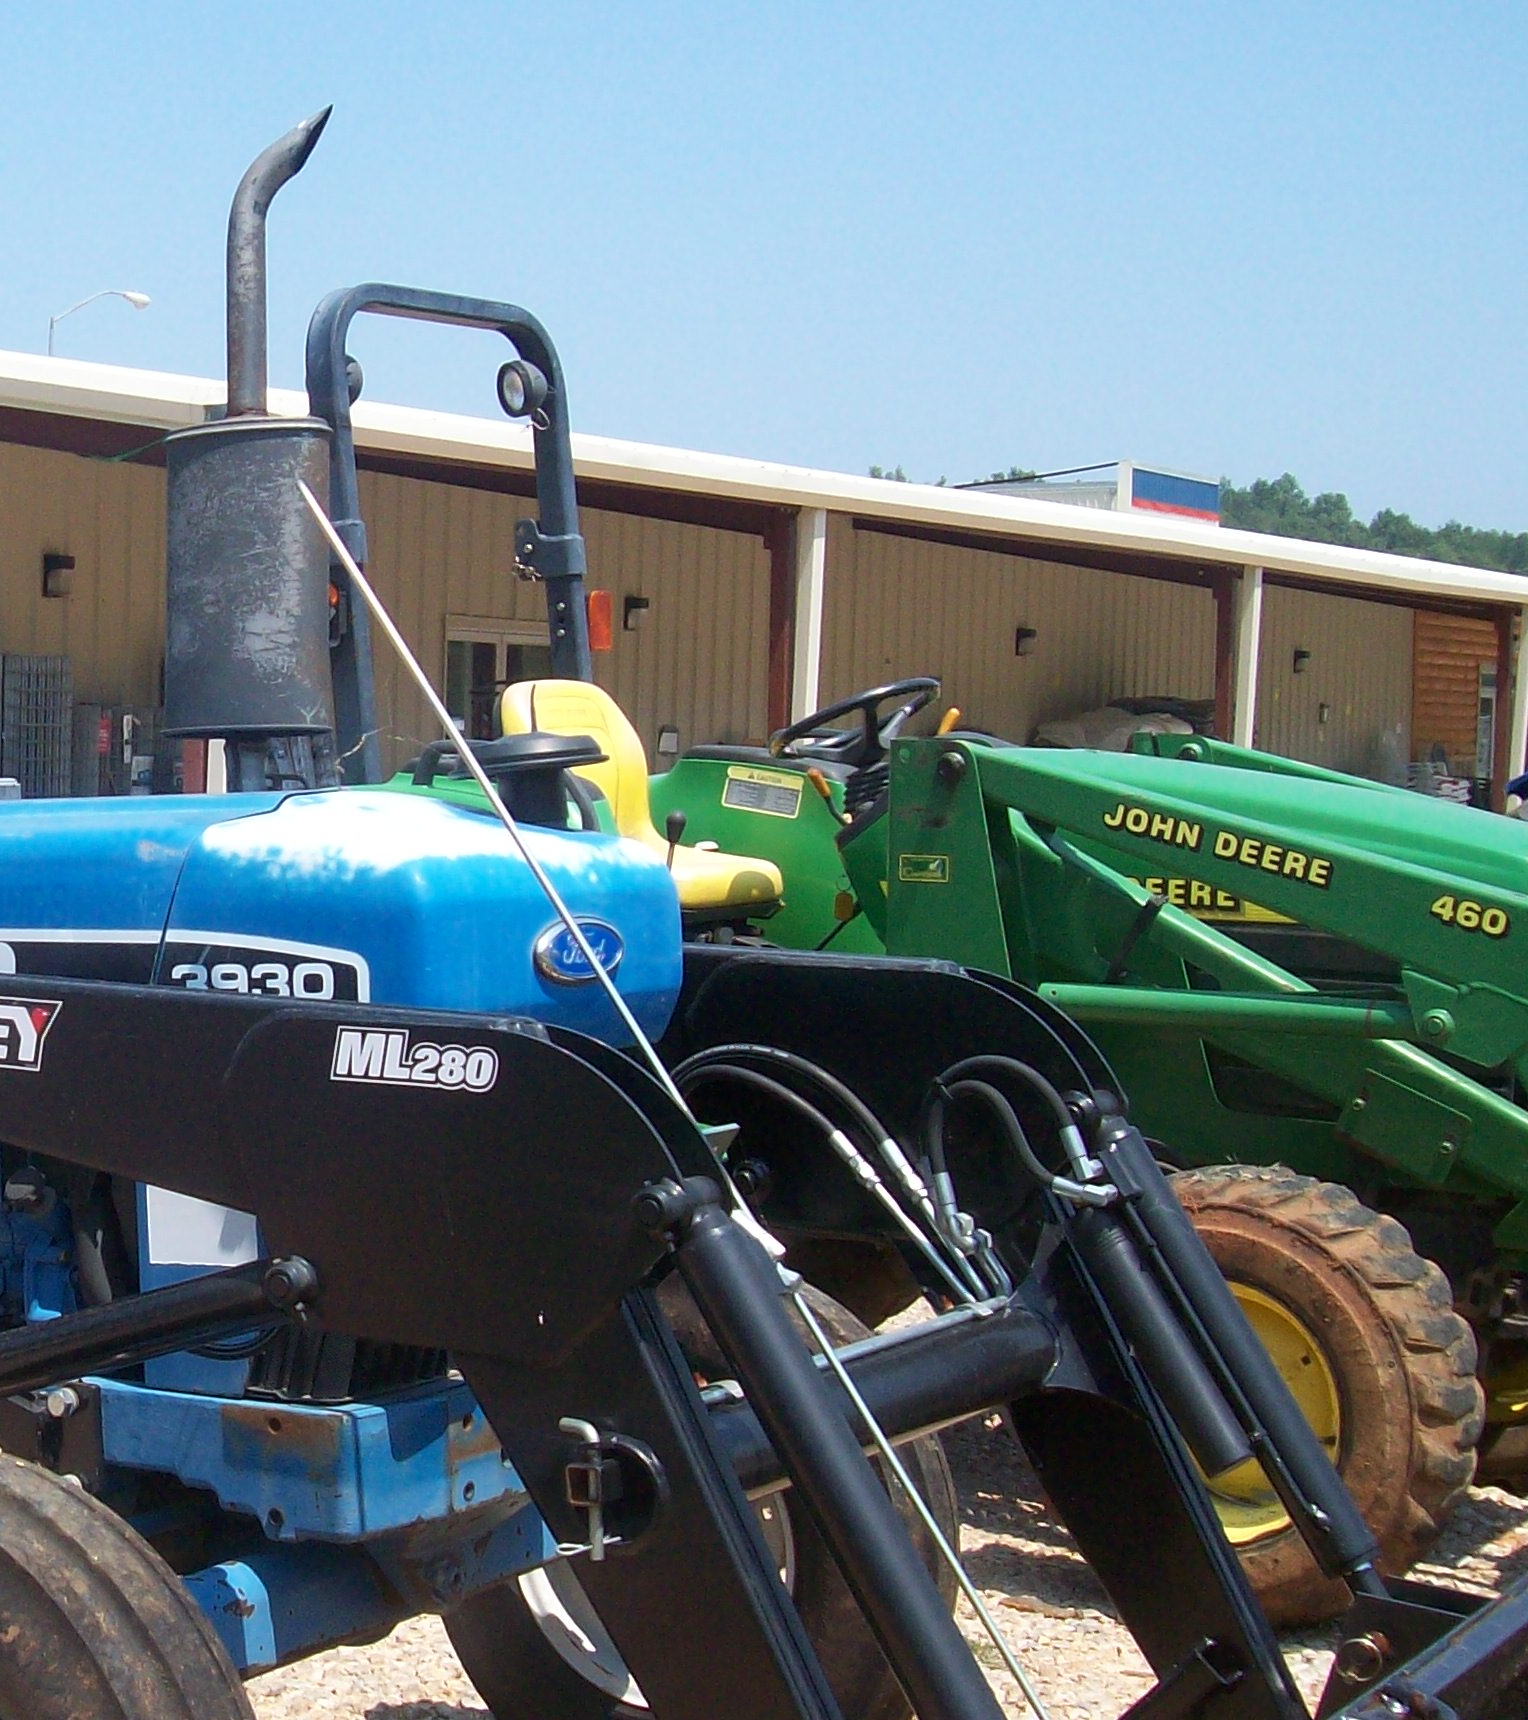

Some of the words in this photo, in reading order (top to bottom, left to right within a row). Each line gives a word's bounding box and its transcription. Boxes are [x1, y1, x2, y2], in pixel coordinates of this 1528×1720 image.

[1103, 804, 1201, 849] JOHN
[1214, 830, 1333, 886] DEERE
[1127, 876, 1236, 908] EERE
[1431, 895, 1508, 935] 460
[172, 963, 334, 1000] 3930
[336, 1032, 494, 1087] ML280
